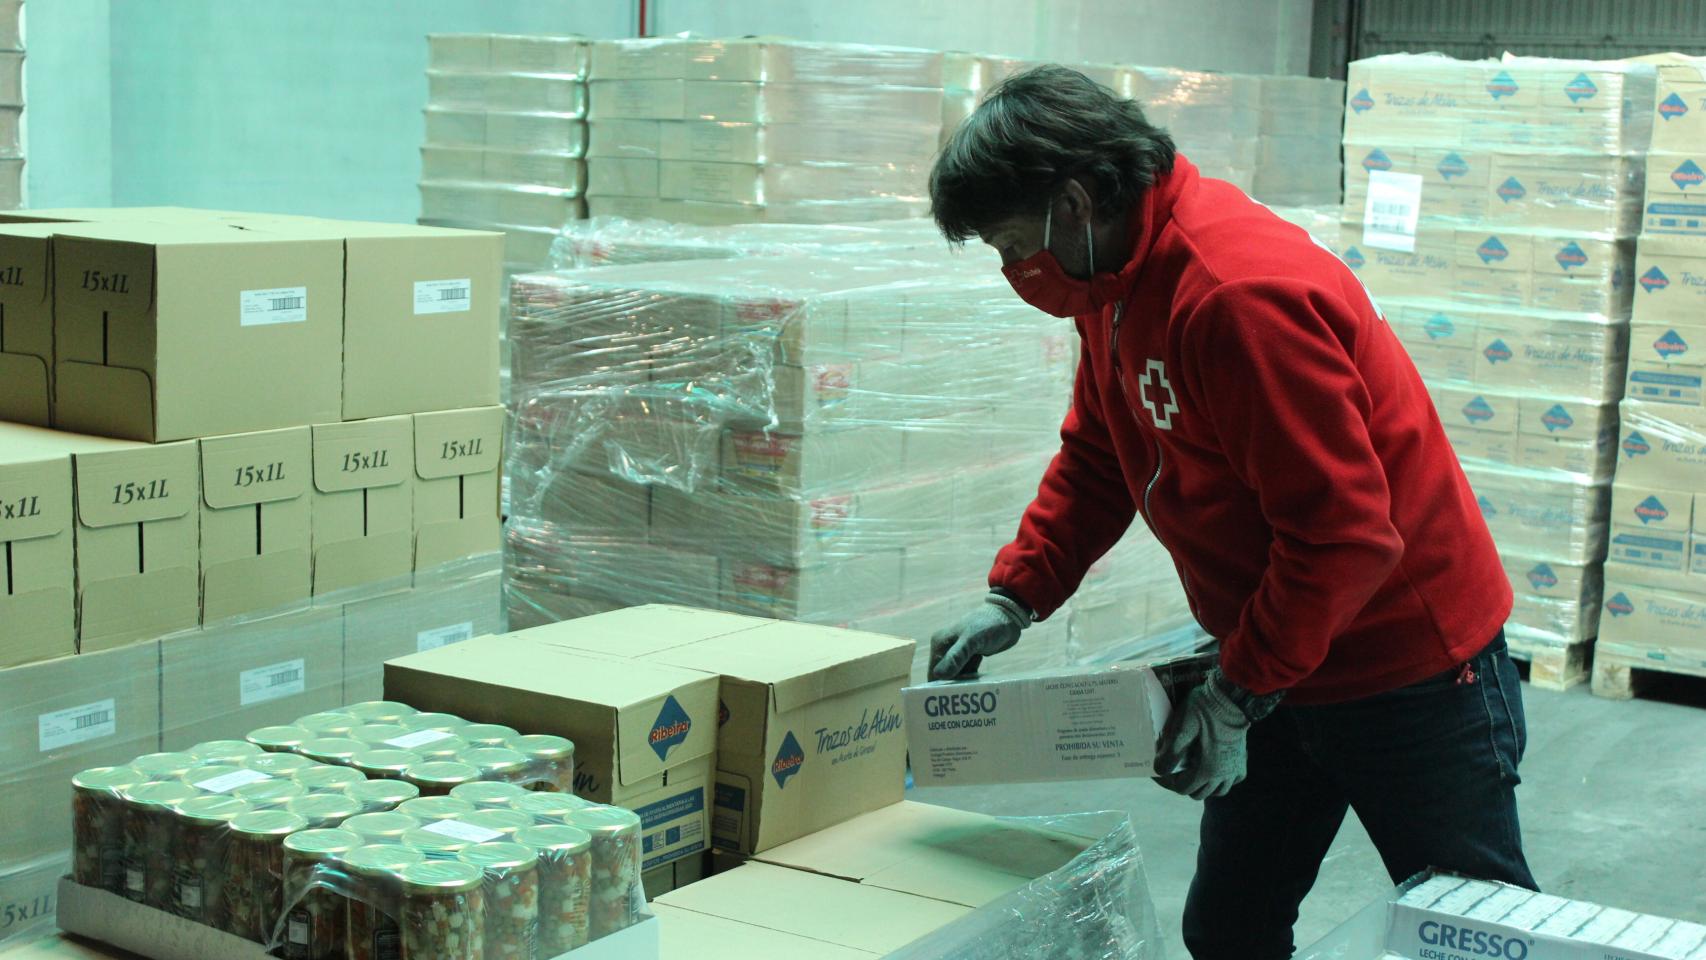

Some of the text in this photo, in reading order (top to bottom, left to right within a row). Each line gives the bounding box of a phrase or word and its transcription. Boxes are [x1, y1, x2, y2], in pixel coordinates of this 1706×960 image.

[82, 269, 129, 294] 15x1L
[341, 449, 389, 473] 15x1L
[440, 437, 483, 461] 15x1L
[234, 461, 286, 488] 15x1L
[112, 478, 169, 505] 15x1L
[0, 495, 41, 520] x1L
[924, 690, 997, 718] GRESSO
[650, 719, 689, 744] Ribeira
[814, 703, 903, 755] Trozos de Atún
[928, 716, 997, 731] LECHE CON CACAO UHT
[1055, 741, 1091, 752] PROHIBIDA
[1418, 919, 1529, 960] GRESSO
